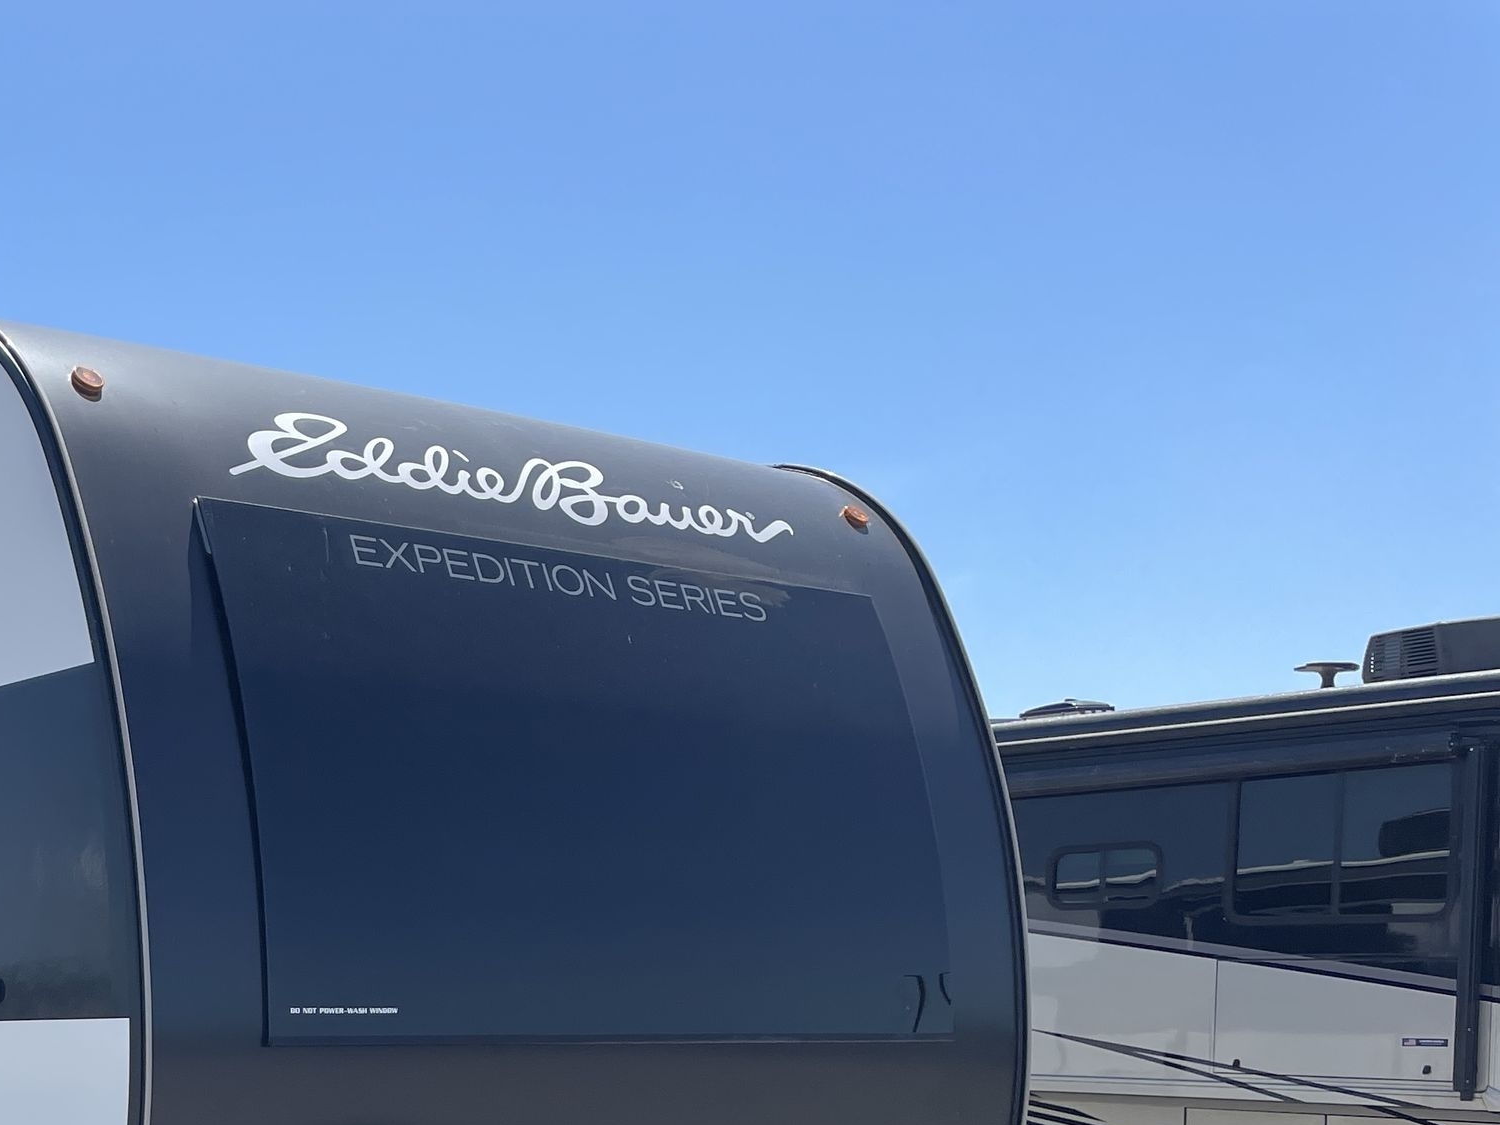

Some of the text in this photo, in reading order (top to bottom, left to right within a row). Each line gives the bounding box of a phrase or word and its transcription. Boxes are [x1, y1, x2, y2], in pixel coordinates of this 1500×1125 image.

[229, 412, 794, 543] Eddie Bauer
[349, 534, 768, 622] EXPEDITION SERIES
